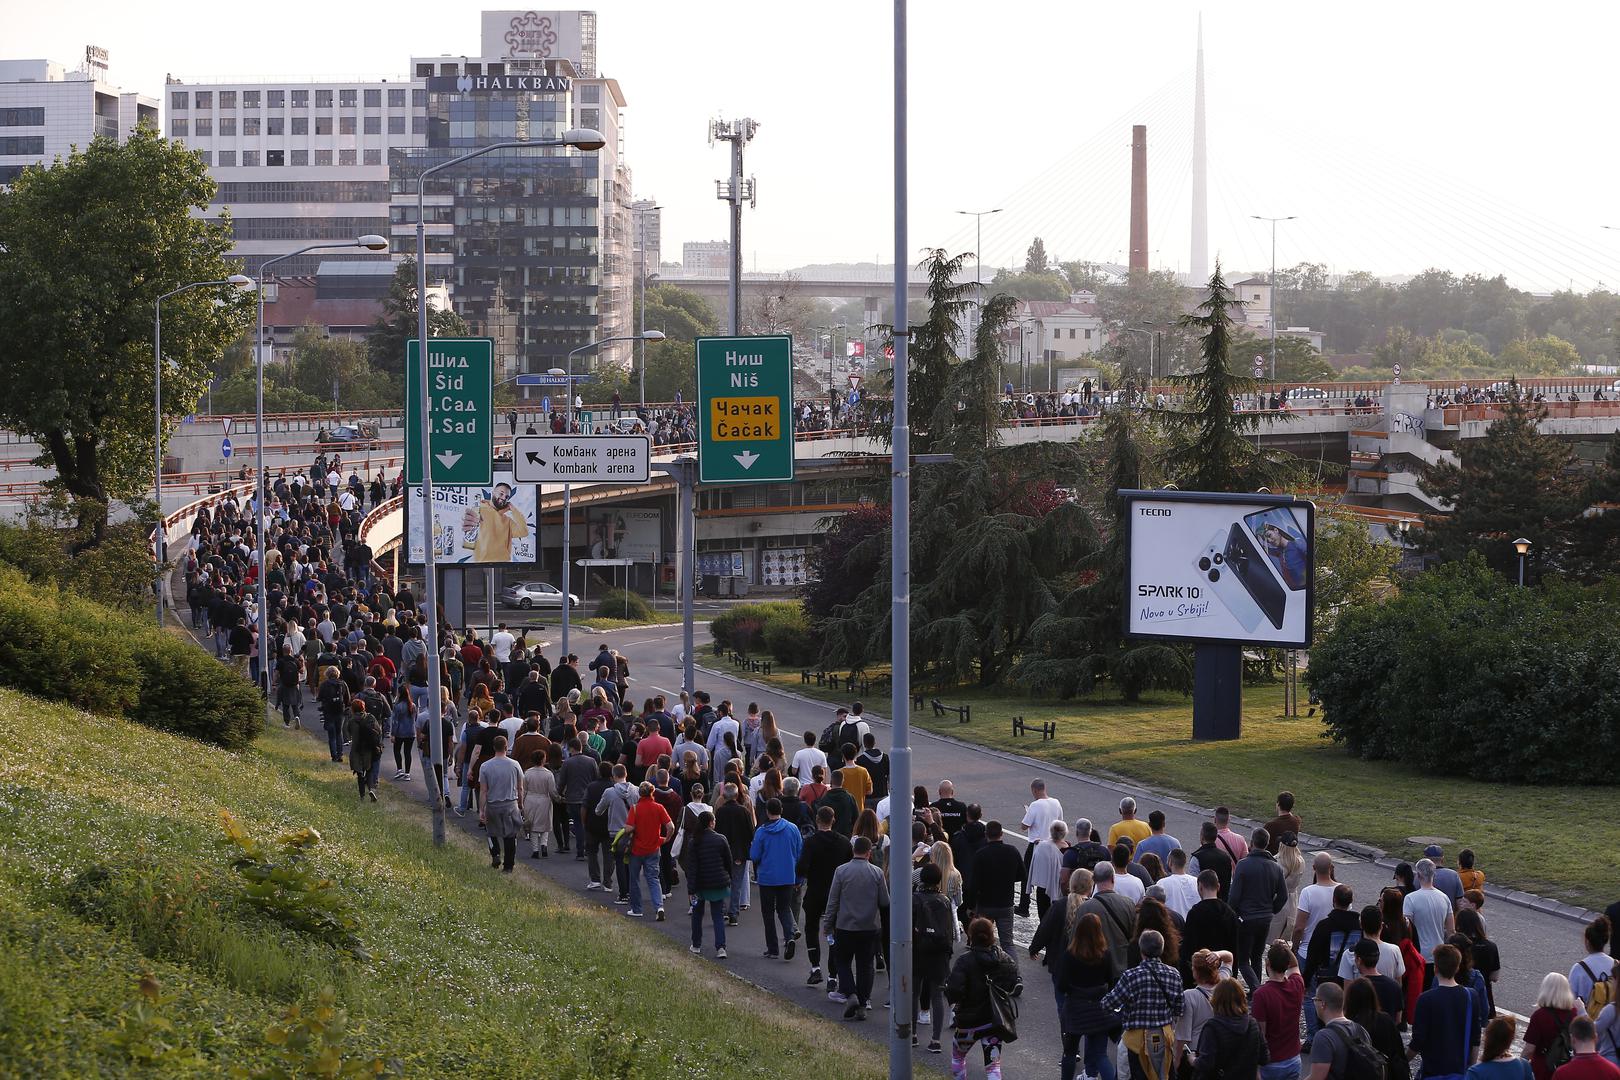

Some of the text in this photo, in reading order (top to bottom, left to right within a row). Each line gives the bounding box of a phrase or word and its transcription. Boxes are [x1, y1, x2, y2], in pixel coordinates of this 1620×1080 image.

[429, 352, 470, 368] Шид
[725, 351, 763, 366] Ниш
[435, 371, 463, 390] Šid
[730, 372, 759, 388] Niš
[717, 401, 773, 416] Чачак
[717, 419, 774, 438] Čačak
[553, 446, 636, 460] Комбанк арена
[553, 462, 635, 474] Kombank arena
[416, 487, 468, 506] SEDI SE!
[1139, 508, 1172, 517] TECNO
[1138, 585, 1183, 598] SPARK
[1187, 587, 1200, 599] 10
[1140, 606, 1164, 620] Novo
[1177, 600, 1210, 617] Srbiji!
